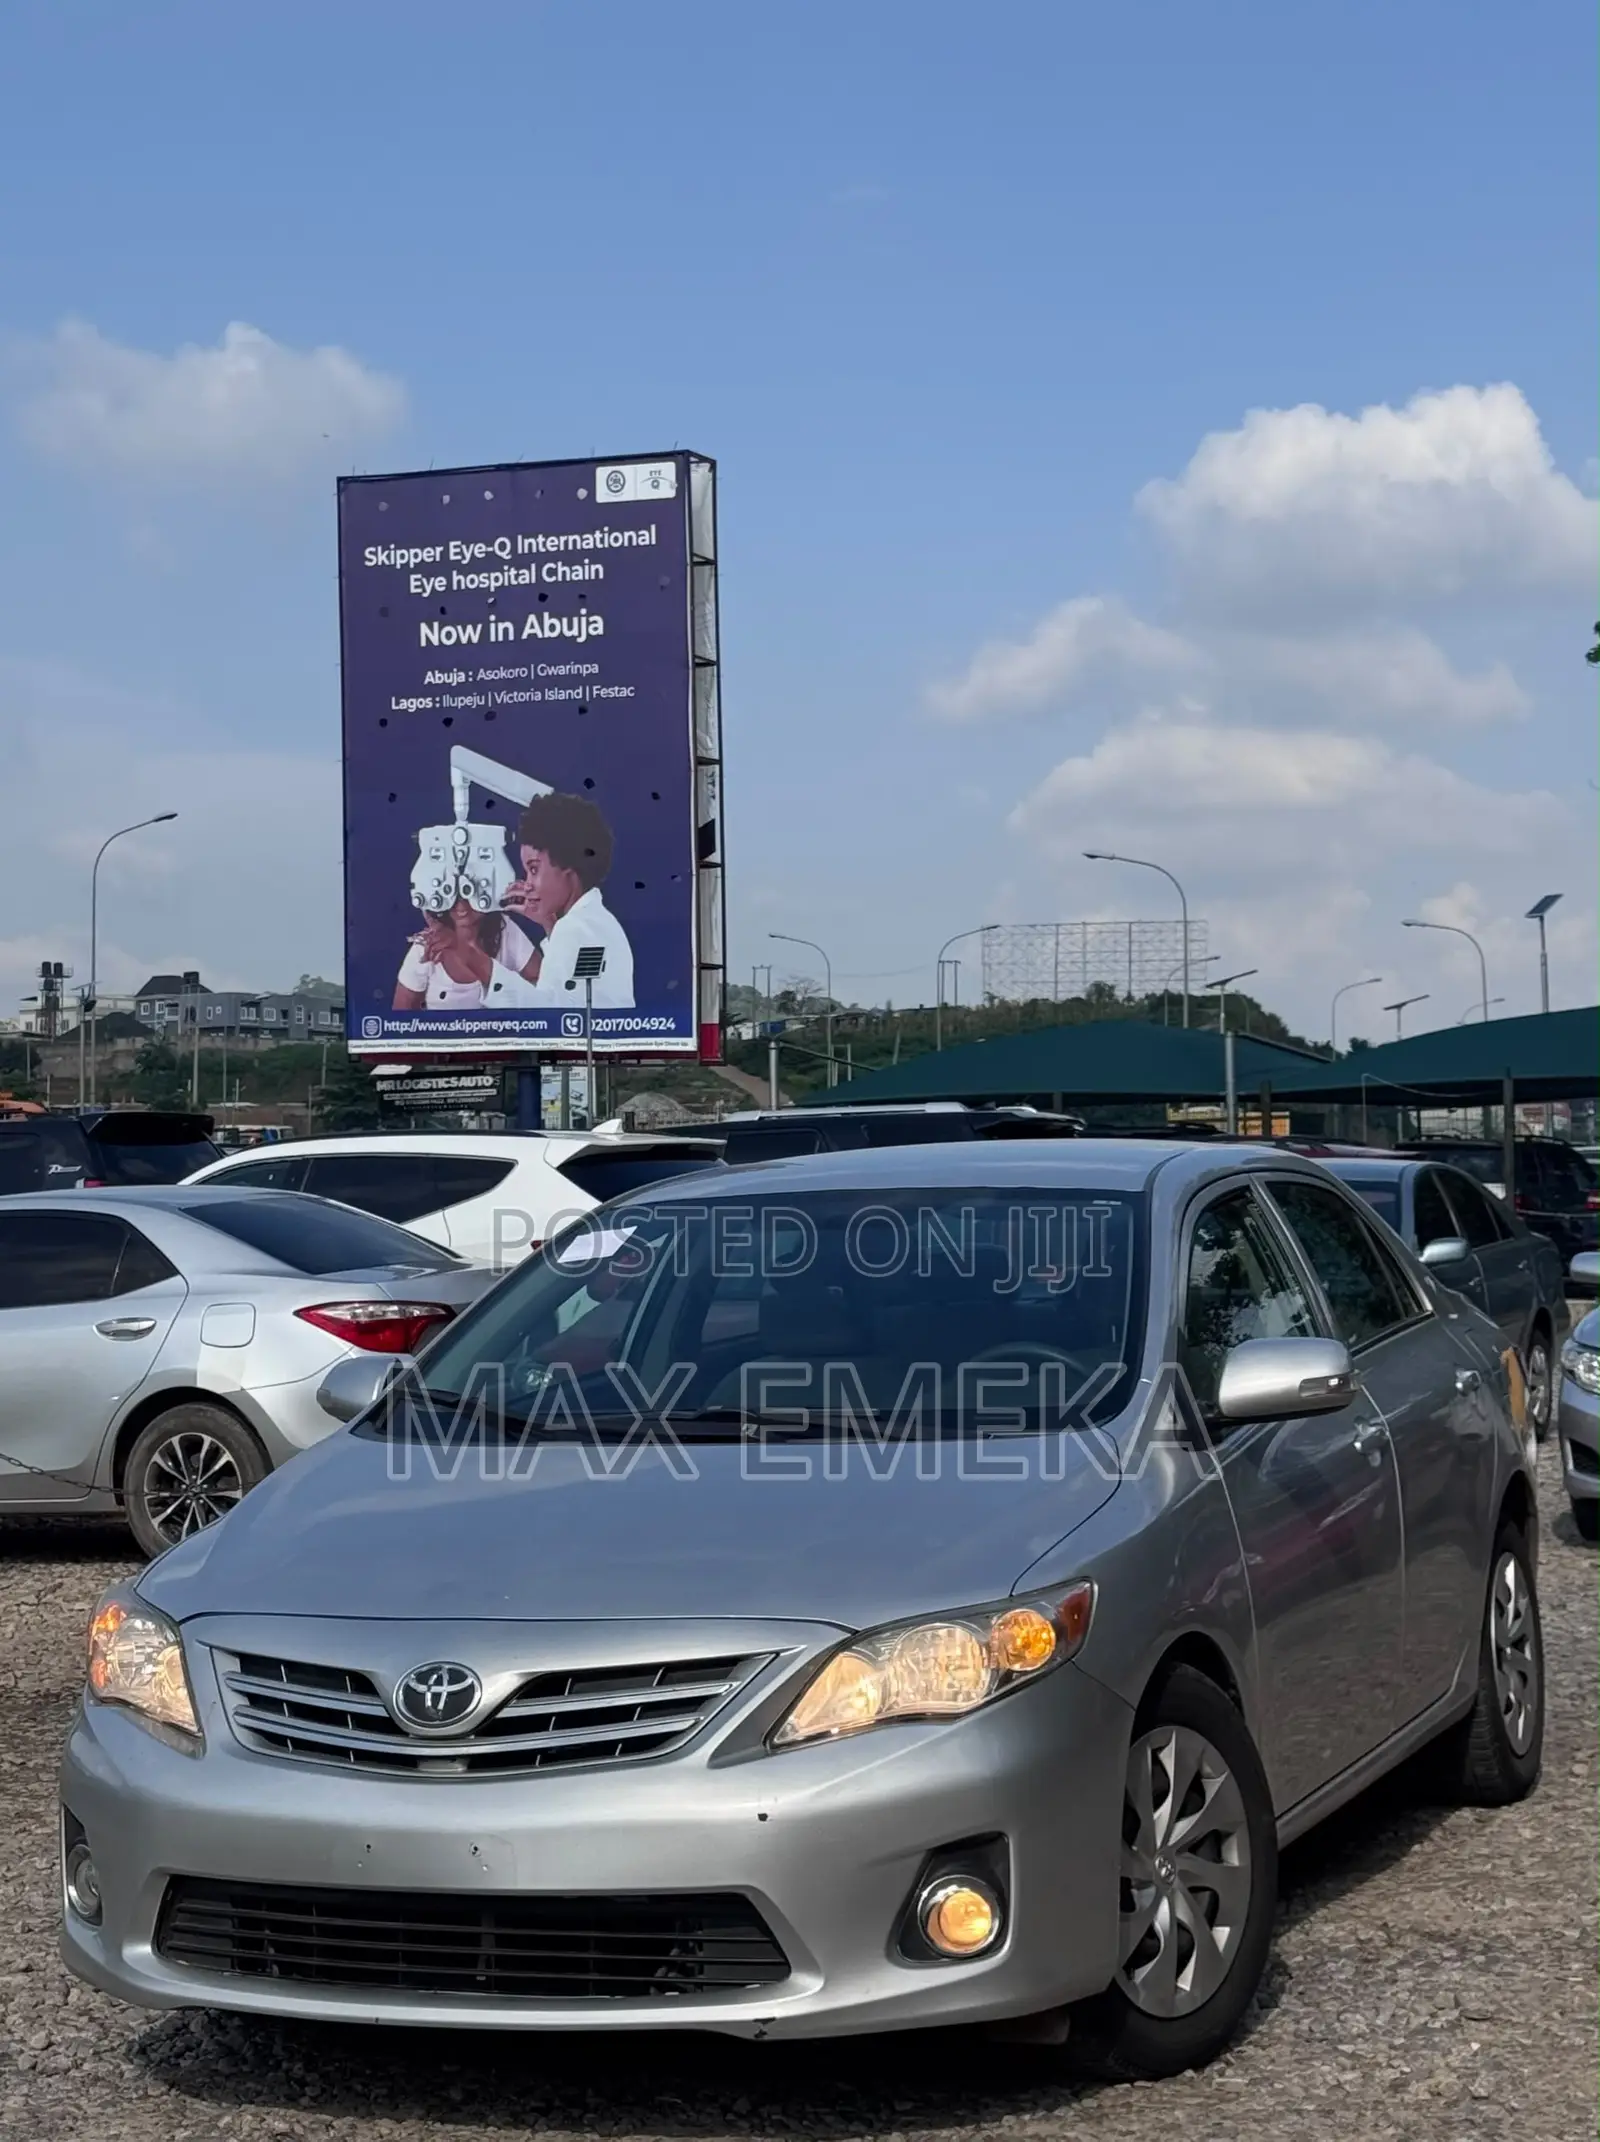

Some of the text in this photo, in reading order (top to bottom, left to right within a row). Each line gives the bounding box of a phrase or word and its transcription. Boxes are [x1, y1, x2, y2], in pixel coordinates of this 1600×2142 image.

[364, 524, 656, 569] Skipper Eye-Q International
[409, 559, 604, 597] Eye hospital Chain
[419, 608, 604, 647] Now in Abuja
[476, 666, 528, 681] Asokoro
[442, 692, 485, 709] Ilupeju
[494, 687, 542, 705] Victoria
[544, 685, 583, 701] Island
[592, 685, 635, 699] Festac
[384, 1018, 547, 1034] http://www.skippereyeq.com
